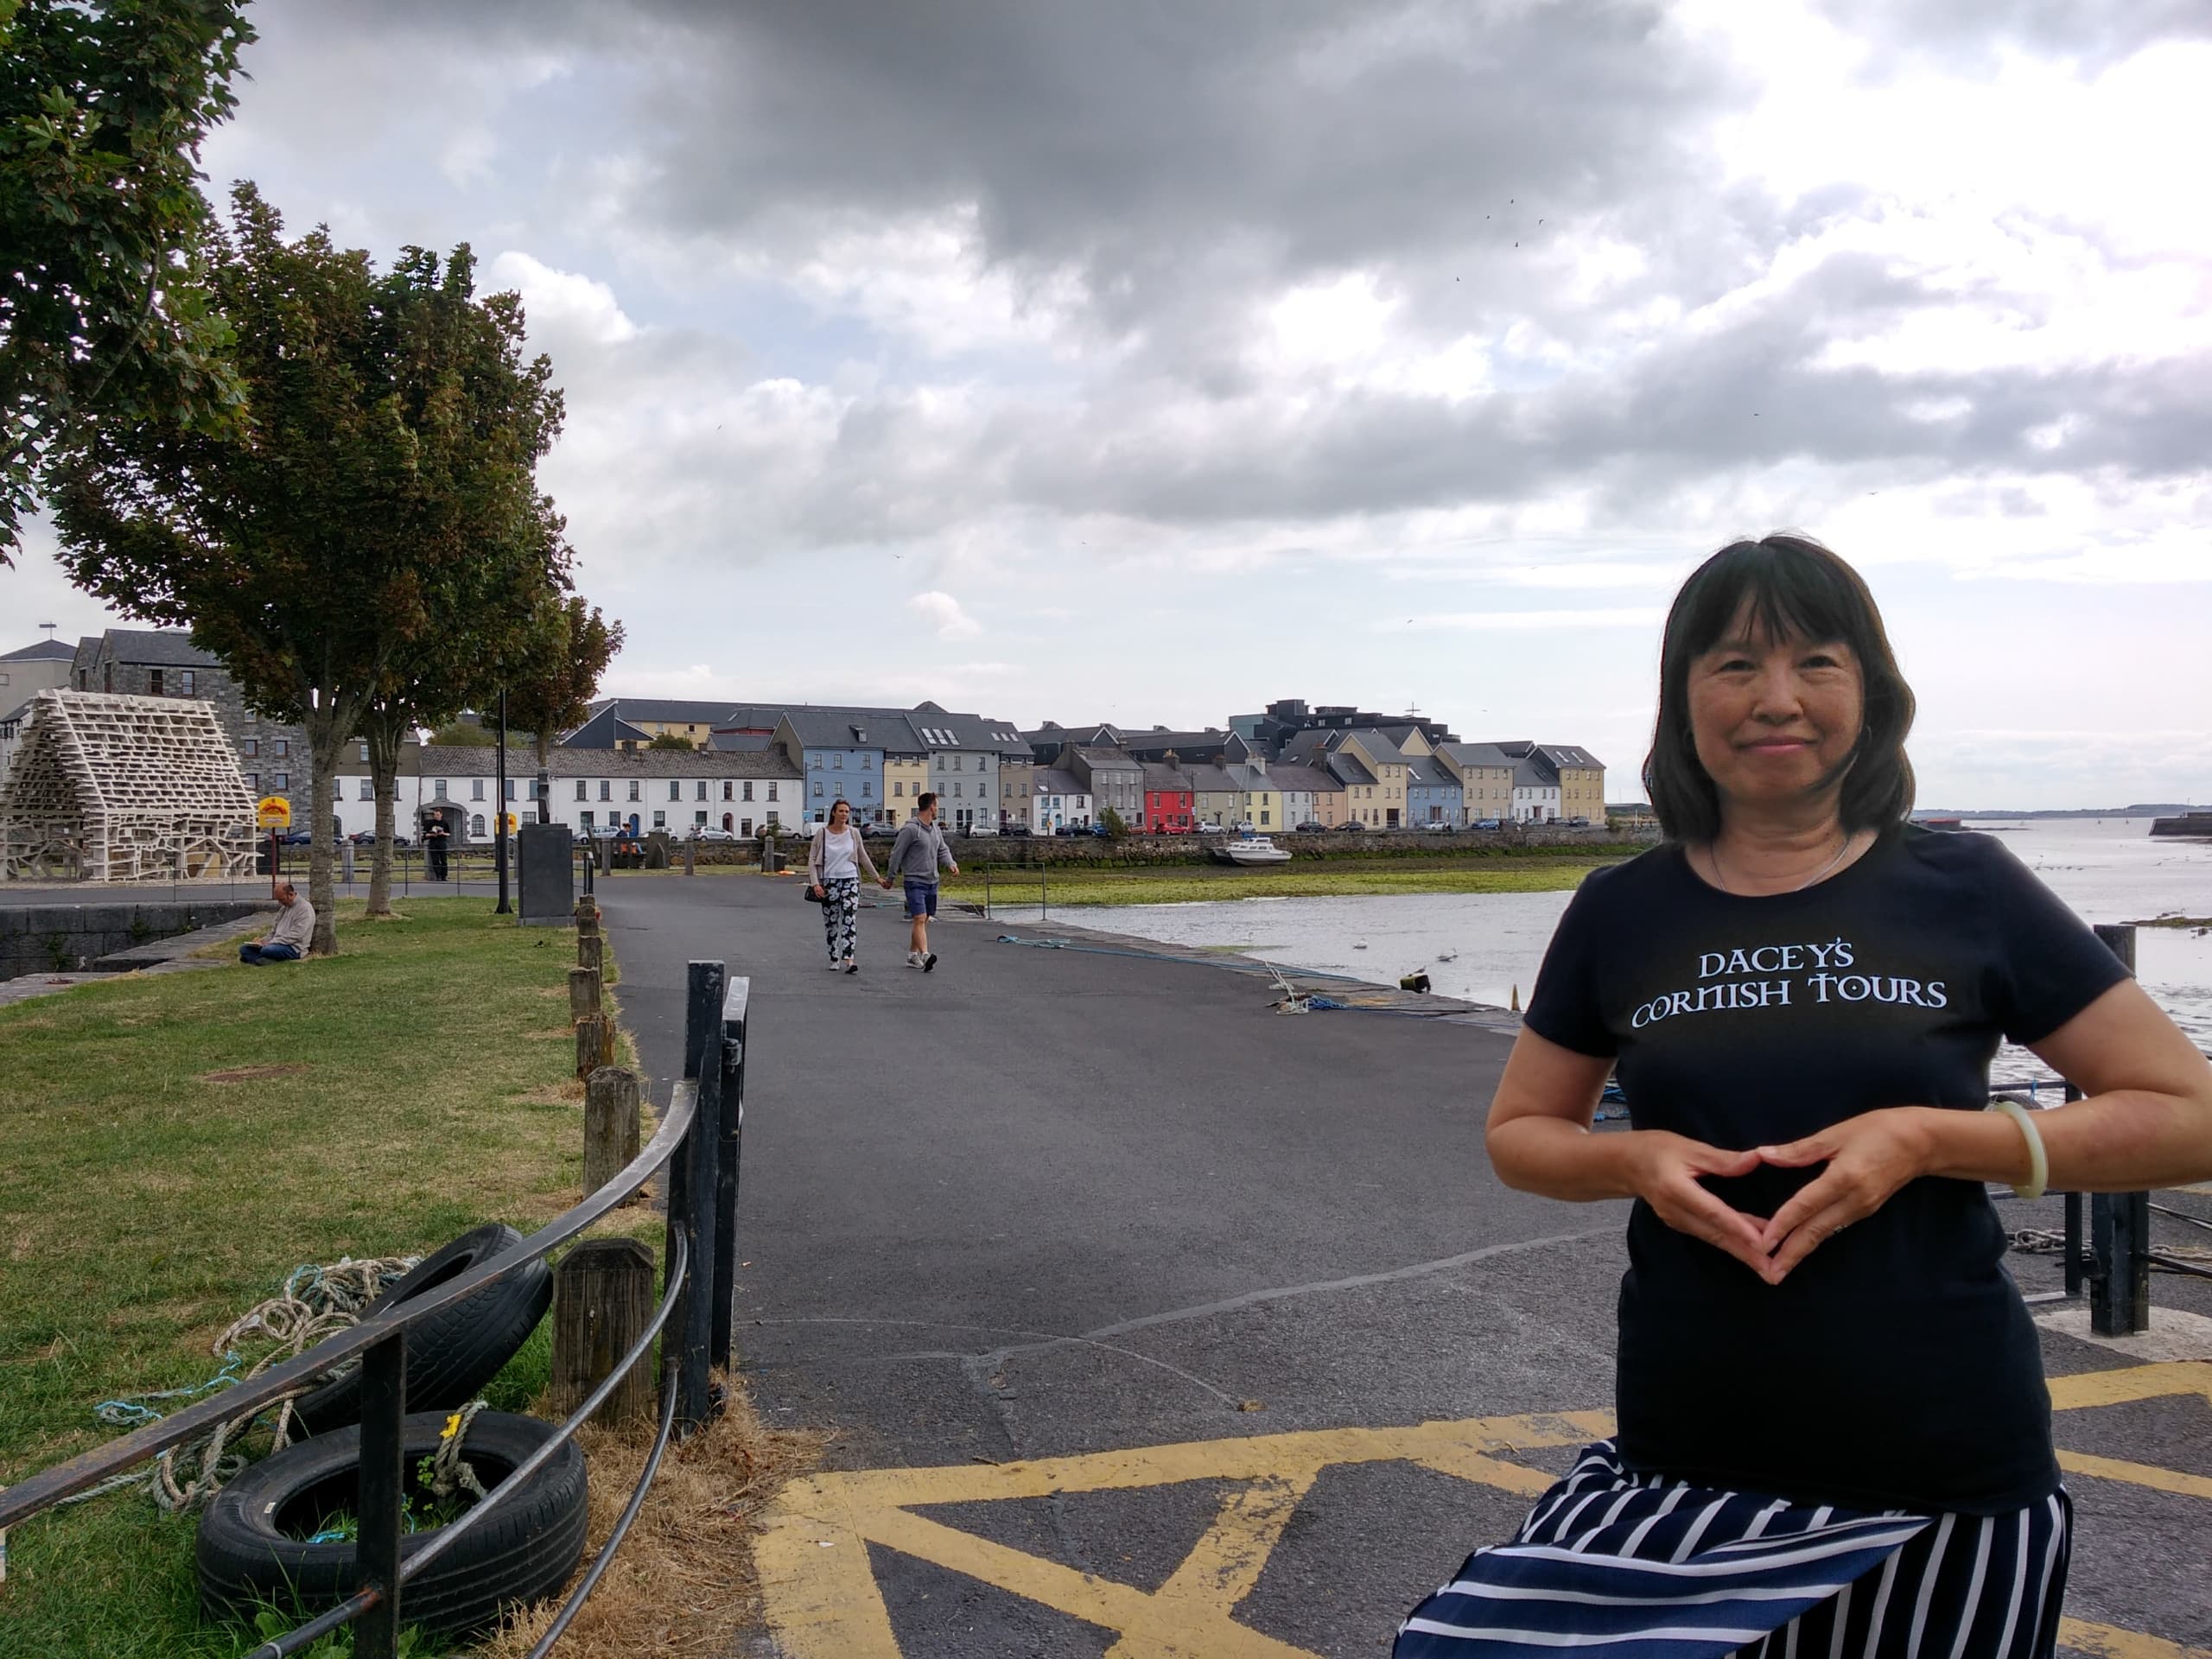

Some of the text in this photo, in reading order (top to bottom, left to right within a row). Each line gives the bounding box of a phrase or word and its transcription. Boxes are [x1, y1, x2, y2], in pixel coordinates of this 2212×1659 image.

[1698, 937, 1854, 978] DACEY'S
[1631, 972, 1948, 1028] CORNISH TOURS
